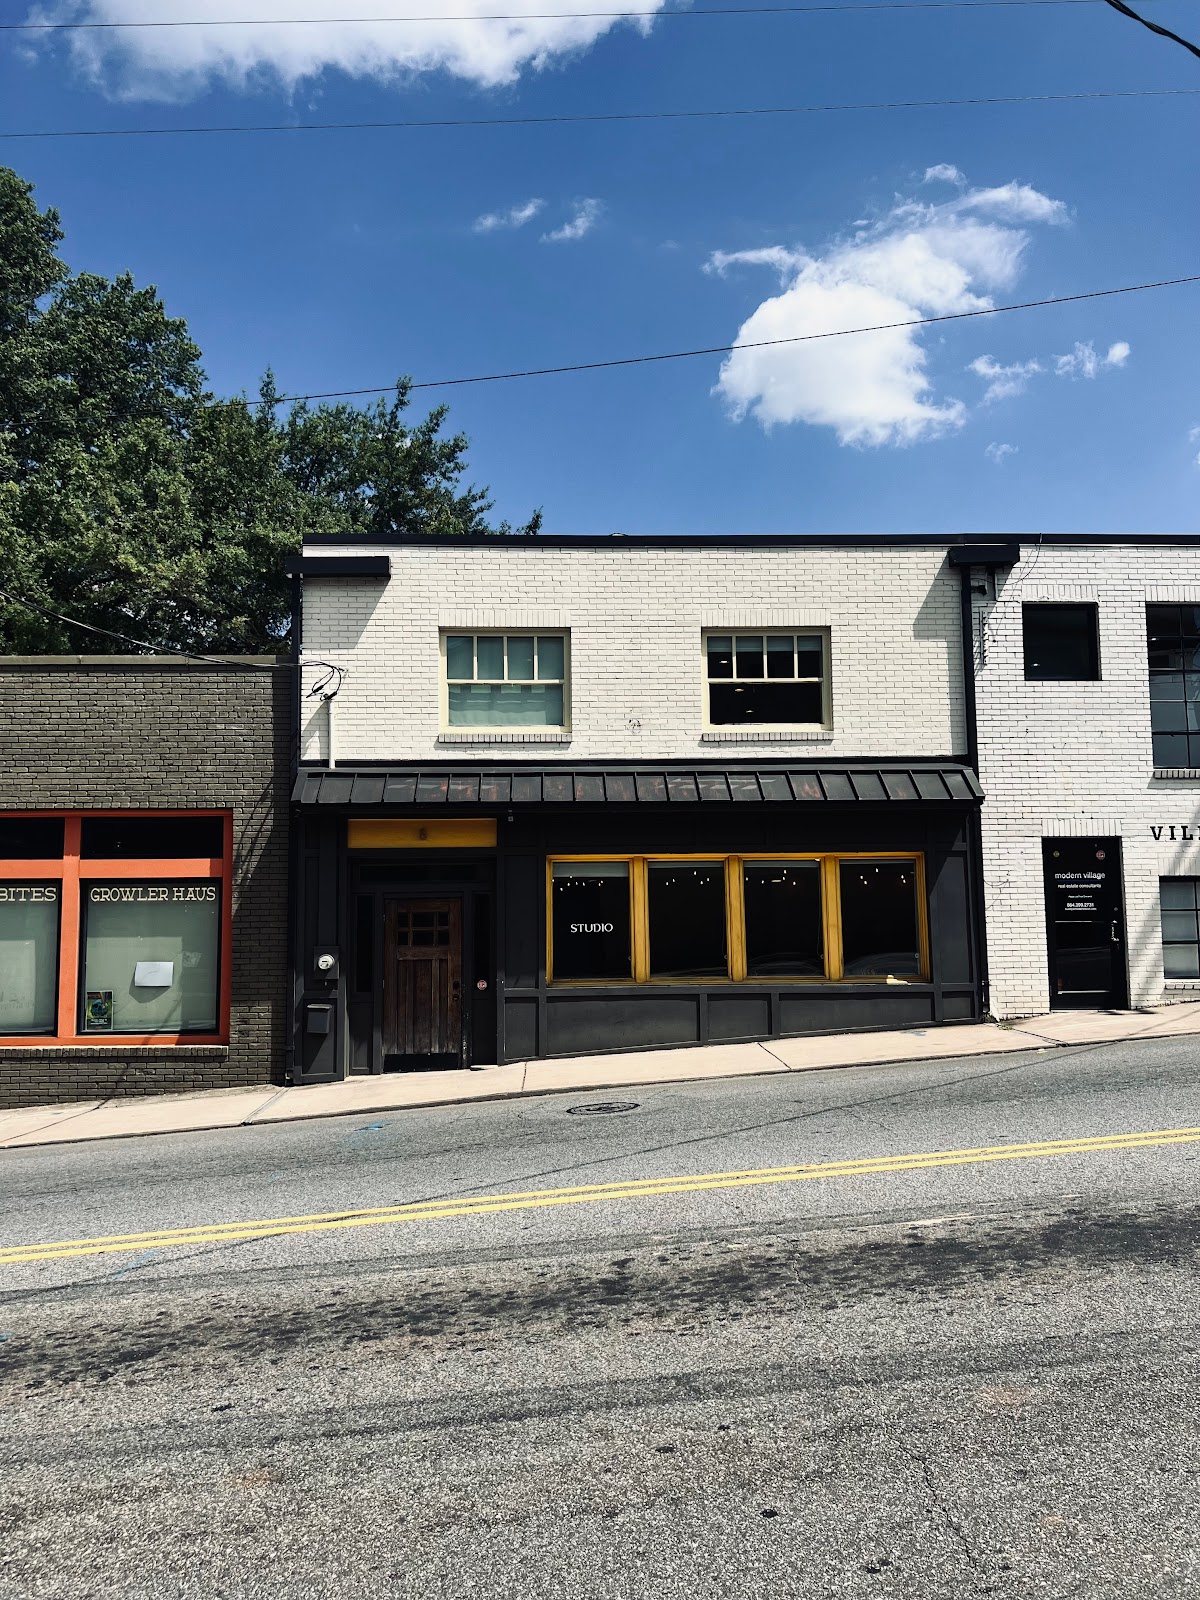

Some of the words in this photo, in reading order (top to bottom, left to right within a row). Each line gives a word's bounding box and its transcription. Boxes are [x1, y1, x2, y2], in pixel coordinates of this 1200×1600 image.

[1150, 825, 1200, 841] VIL
[1055, 871, 1082, 879] modern
[1083, 871, 1106, 880] village
[0, 887, 57, 902] BITES
[90, 887, 169, 902] GROWLER
[172, 887, 216, 901] HAUS
[570, 922, 614, 933] STUDIO
